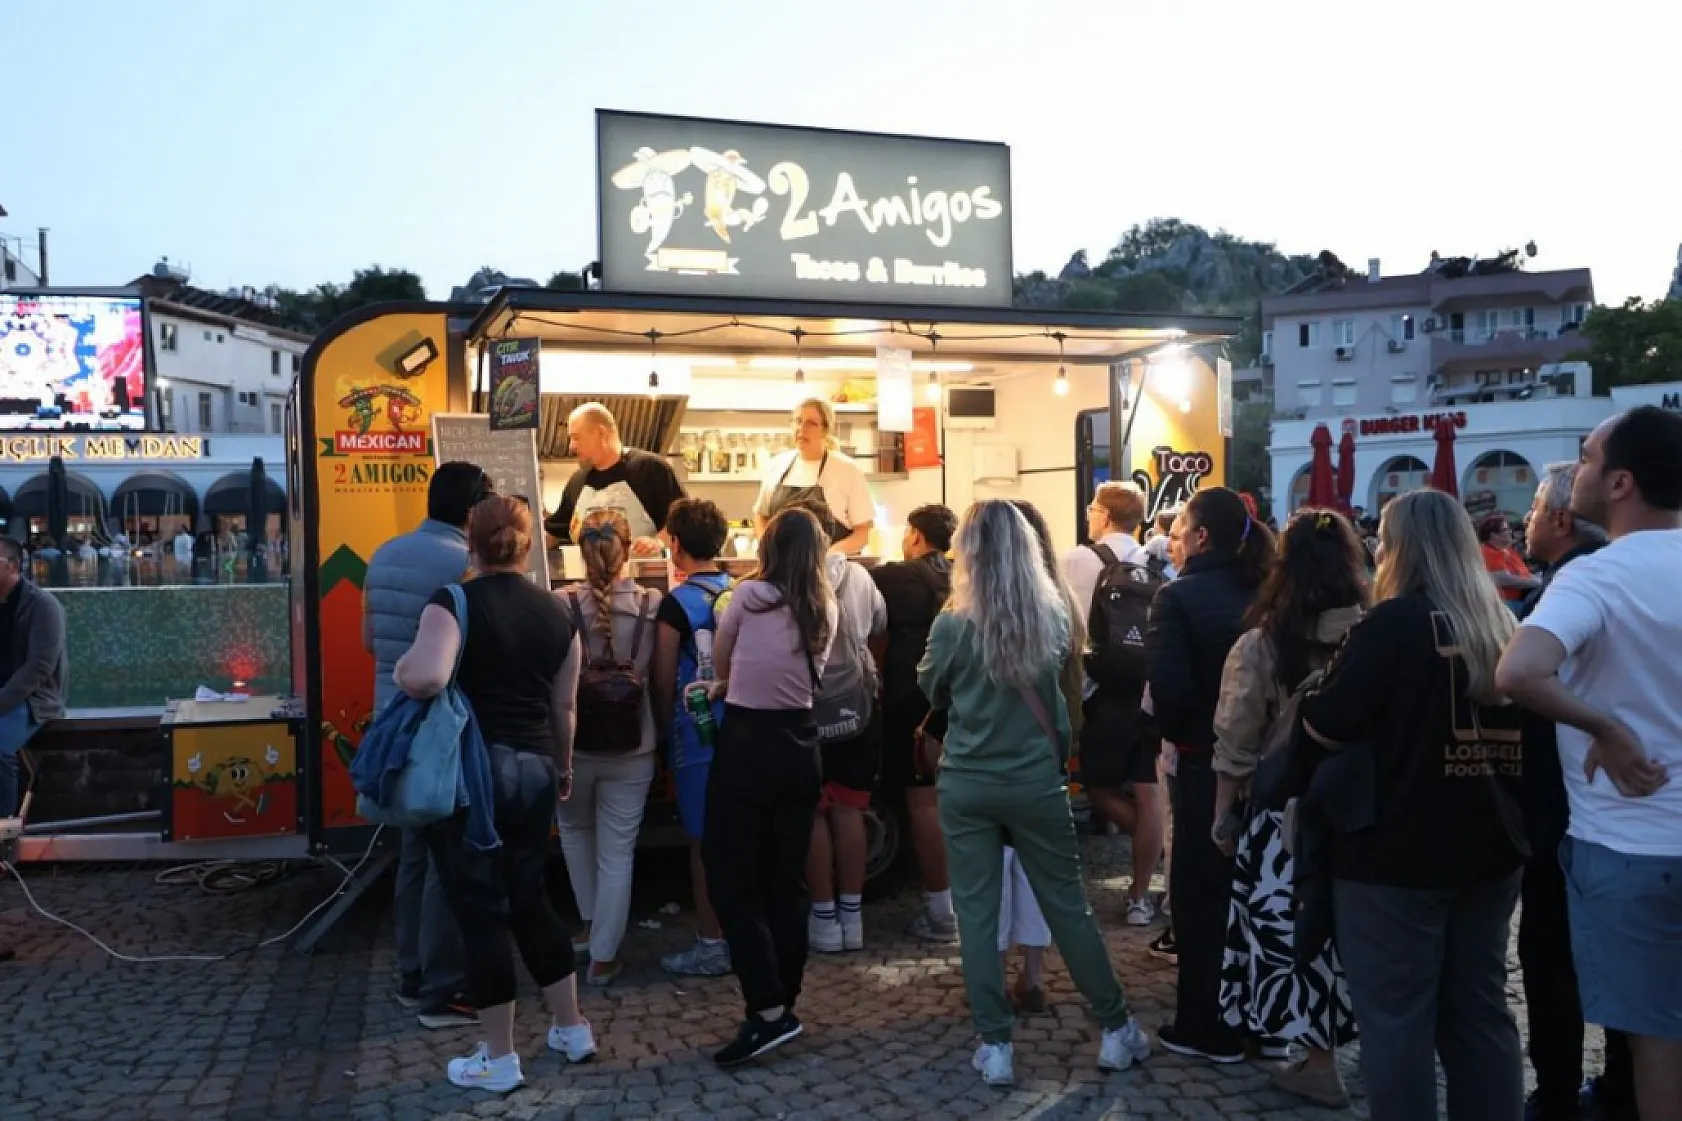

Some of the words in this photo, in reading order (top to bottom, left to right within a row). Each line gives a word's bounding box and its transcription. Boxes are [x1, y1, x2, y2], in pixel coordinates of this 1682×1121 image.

[768, 161, 820, 241] 2
[818, 172, 1003, 247] Amigos
[1360, 415, 1420, 436] BURGER
[85, 437, 211, 458] MEYDANI
[341, 433, 421, 449] MEXICAN
[1156, 450, 1210, 473] Taco
[334, 463, 348, 485] 2
[350, 463, 429, 485] AMIGOS
